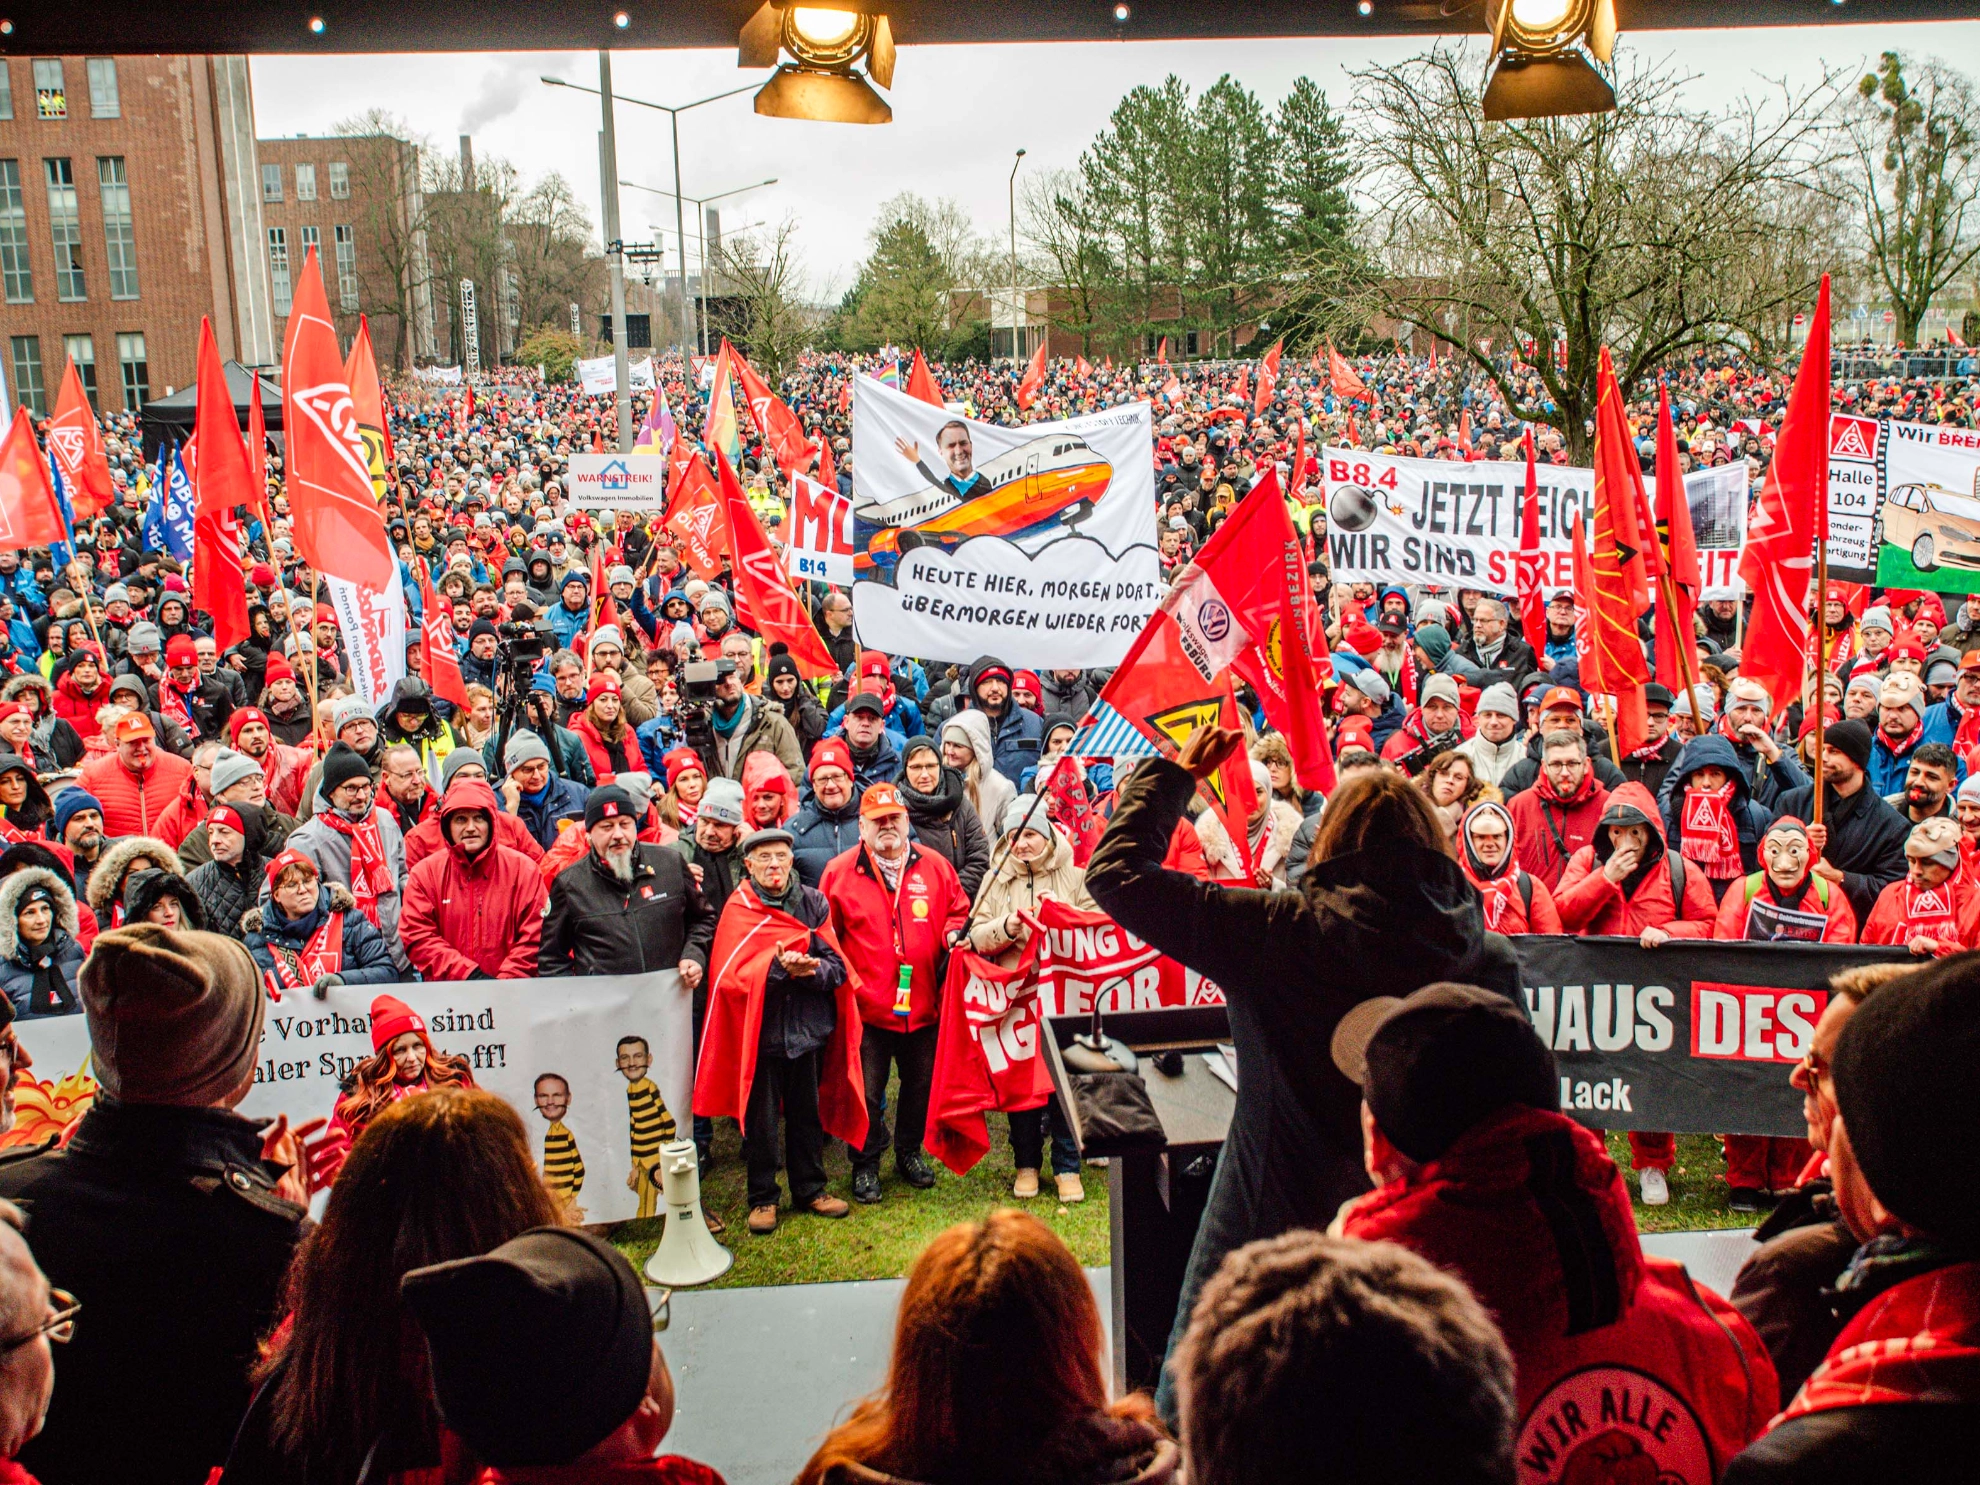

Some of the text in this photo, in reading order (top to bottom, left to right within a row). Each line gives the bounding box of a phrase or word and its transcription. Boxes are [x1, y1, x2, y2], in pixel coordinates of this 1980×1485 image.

[1896, 425, 1934, 444] Wir
[577, 473, 653, 483] WARNSTREIK!
[1329, 459, 1398, 491] B8.4
[1829, 469, 1873, 485] Halle
[578, 494, 654, 502] Volkswagen Immobilien
[1412, 480, 1503, 537] JETZT
[1833, 492, 1866, 507] 104
[1828, 522, 1863, 532] onder-
[1829, 534, 1869, 548] hrzeug-
[1329, 534, 1392, 570] WIR
[1403, 536, 1477, 577] SIND
[1827, 547, 1866, 561] rtigung
[799, 557, 827, 577] B14
[912, 563, 978, 589] HEUTE
[984, 574, 1034, 597] HIER,
[1041, 581, 1111, 602] MORGEN
[1045, 613, 1107, 634] WIEDER
[1180, 612, 1212, 666] olkswagen
[274, 1007, 373, 1041] Vorha
[431, 1007, 496, 1033] sind
[1524, 984, 1817, 1059] HAUS DES
[1560, 1076, 1633, 1113] Lack
[1521, 1387, 1678, 1473] WIR ALLE
